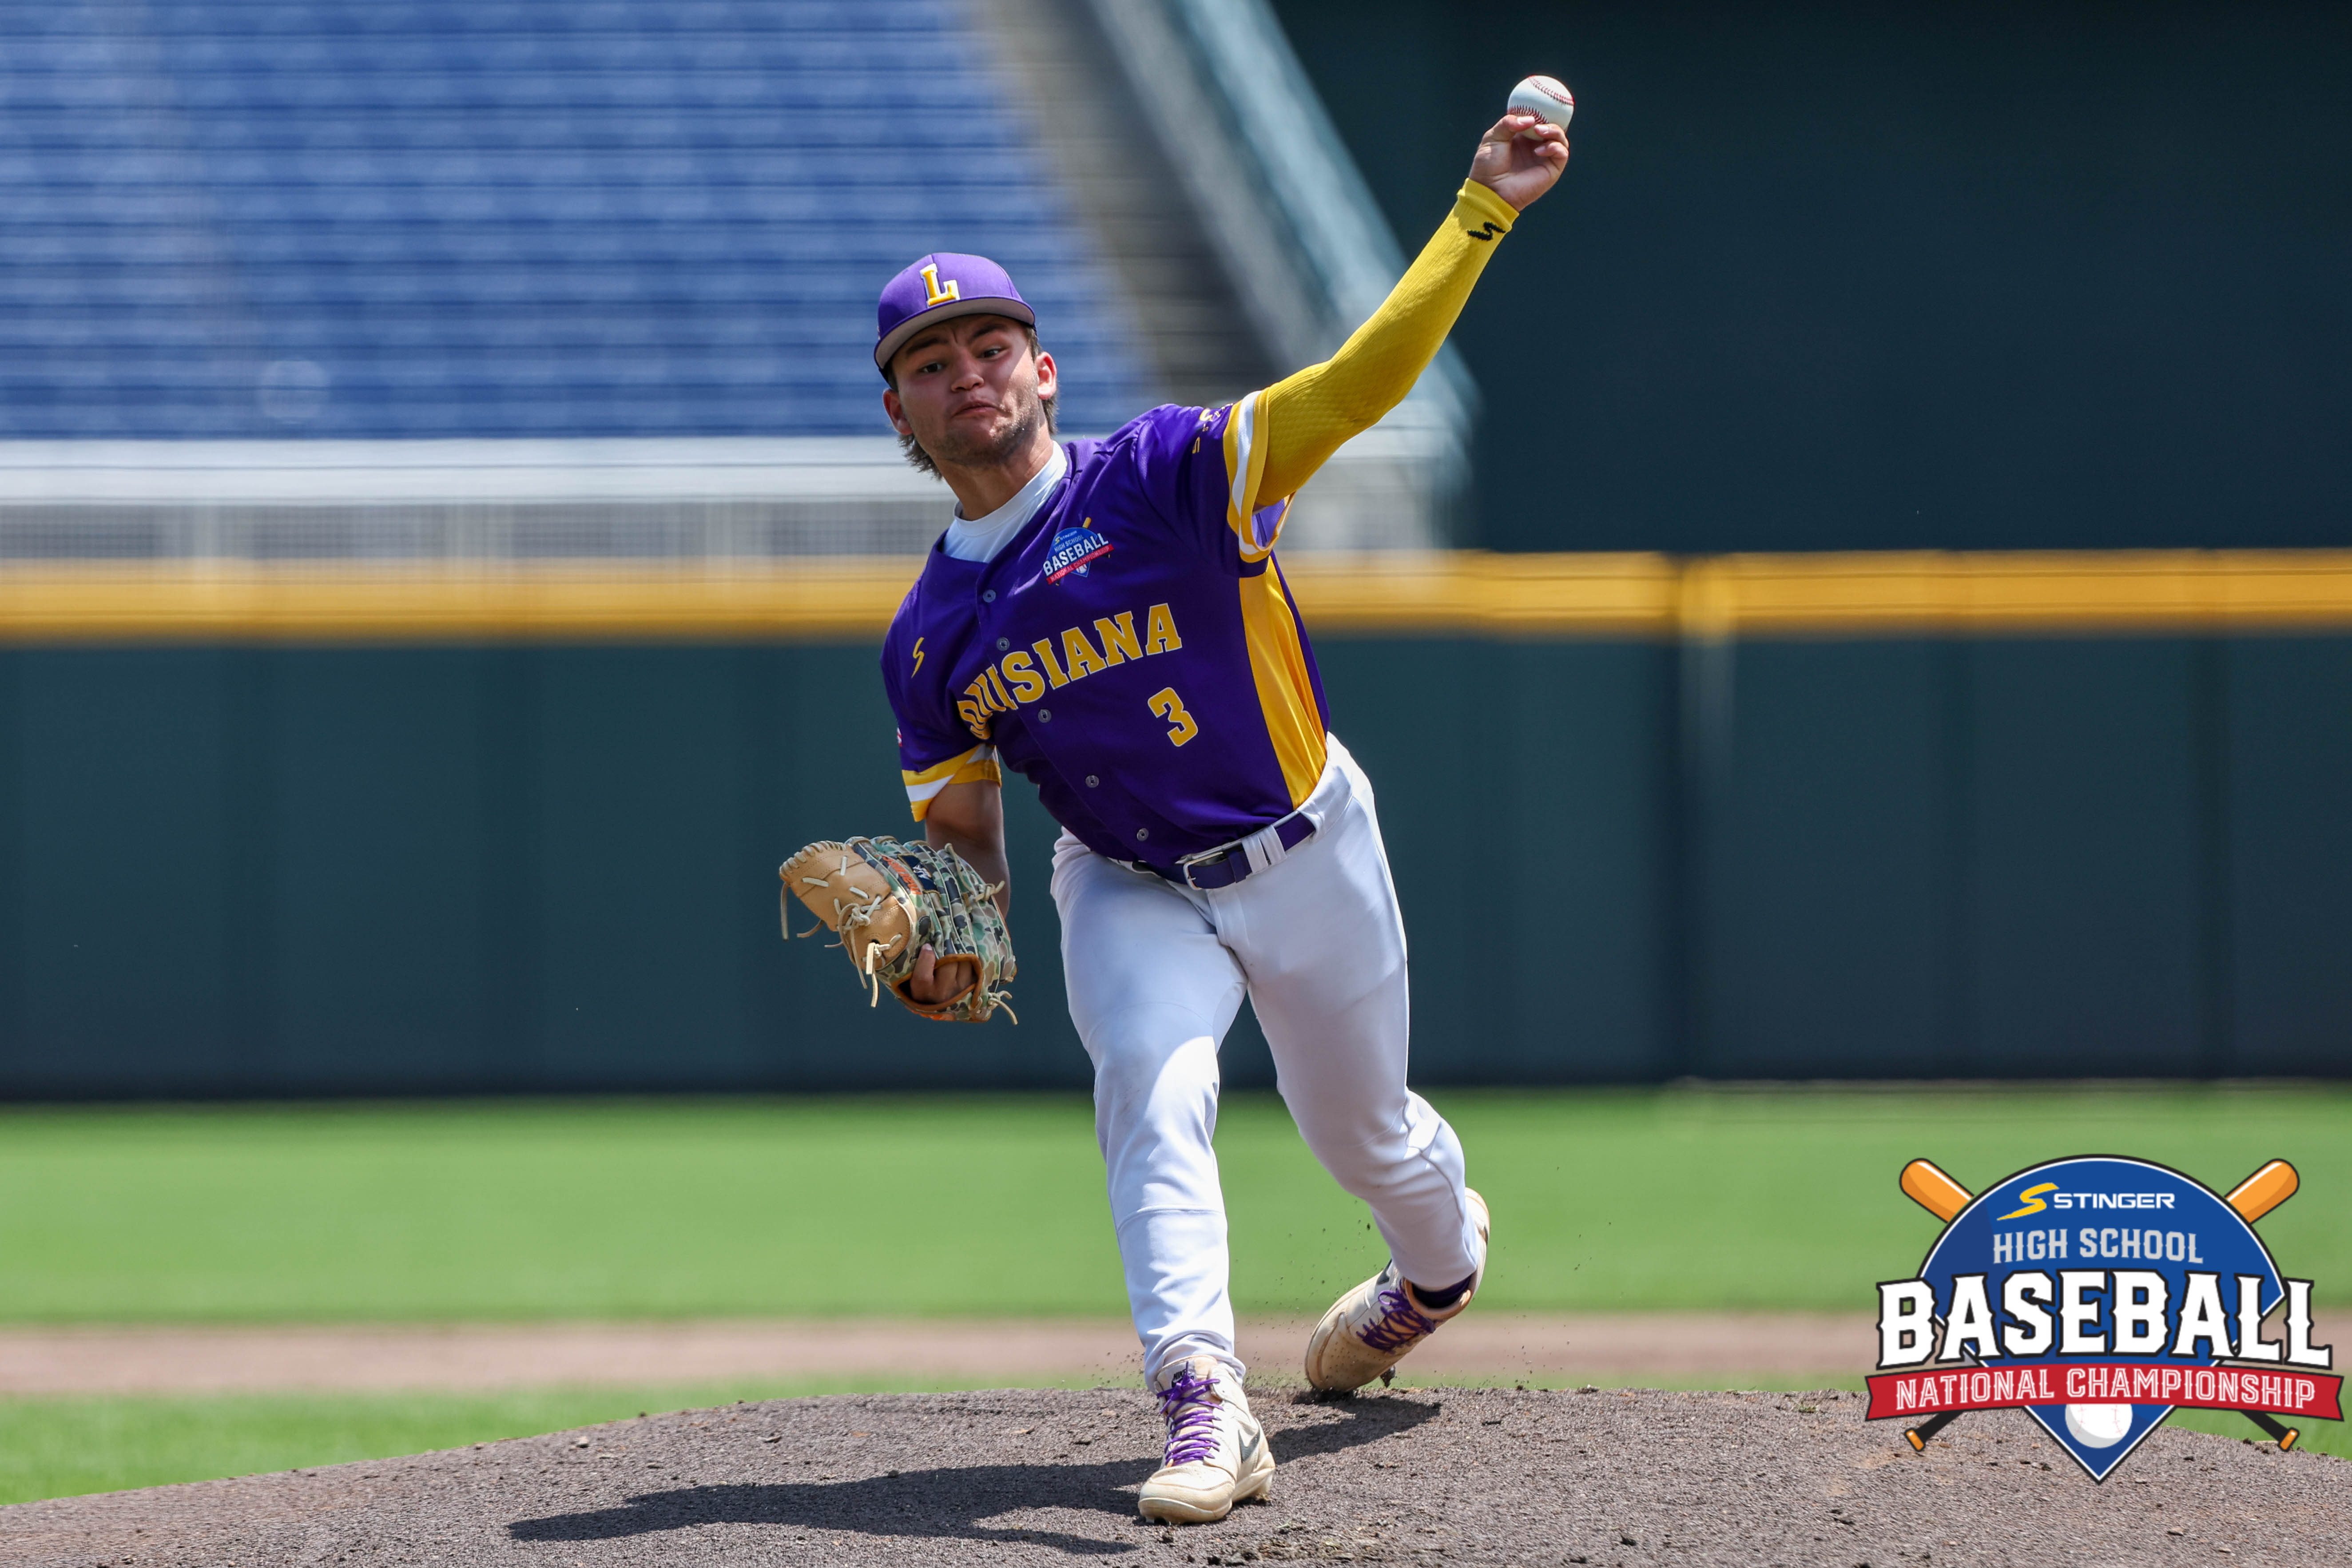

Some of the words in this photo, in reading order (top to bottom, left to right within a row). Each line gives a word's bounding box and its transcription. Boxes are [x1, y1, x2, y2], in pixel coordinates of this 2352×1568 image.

[920, 263, 961, 307] L
[1043, 533, 1109, 576] BASEBALL
[1050, 564, 1074, 582] NATIONAL
[1074, 546, 1110, 568] CHAMPIONSHIP
[1054, 542, 1066, 553] HIGH
[1066, 534, 1085, 547] SCHOOL
[1147, 687, 1199, 747] 3
